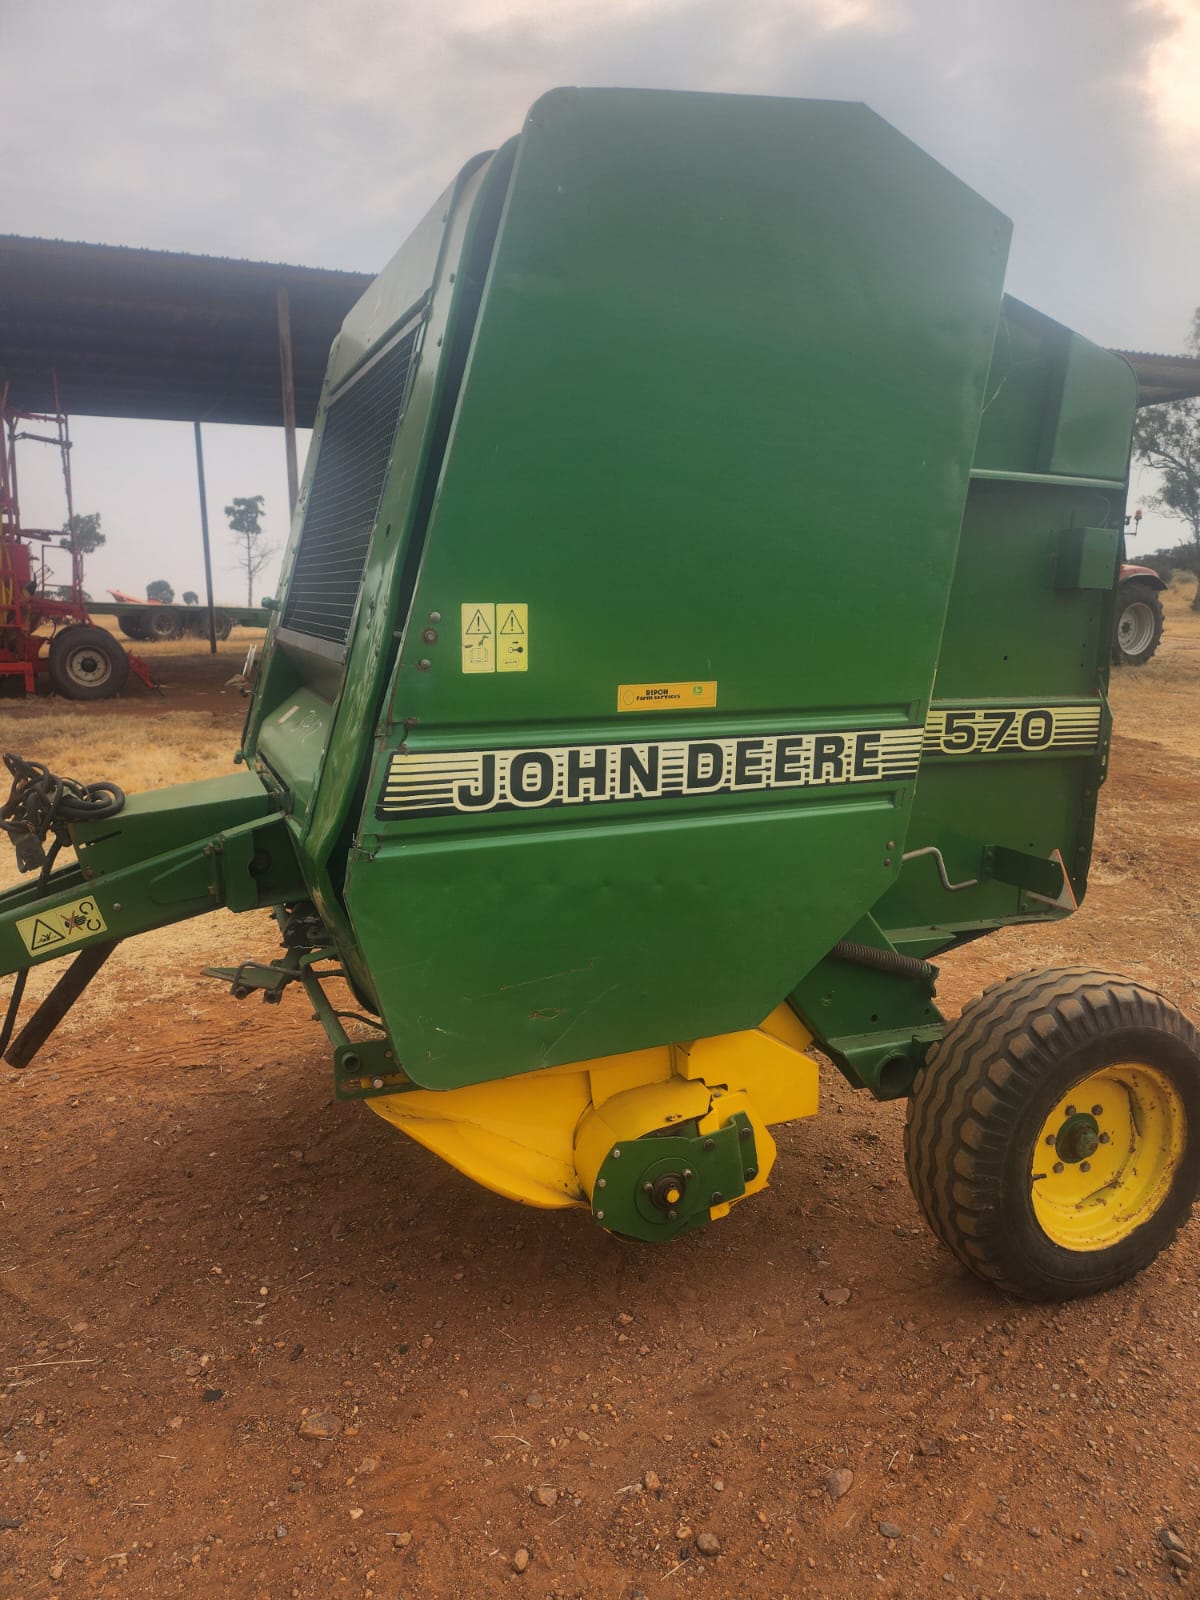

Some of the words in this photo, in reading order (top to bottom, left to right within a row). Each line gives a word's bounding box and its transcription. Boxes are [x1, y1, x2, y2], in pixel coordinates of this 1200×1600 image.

[645, 688, 669, 696] RIPON
[942, 709, 1055, 752] 570
[455, 745, 662, 809] JOHN
[686, 732, 883, 792] DEERE
